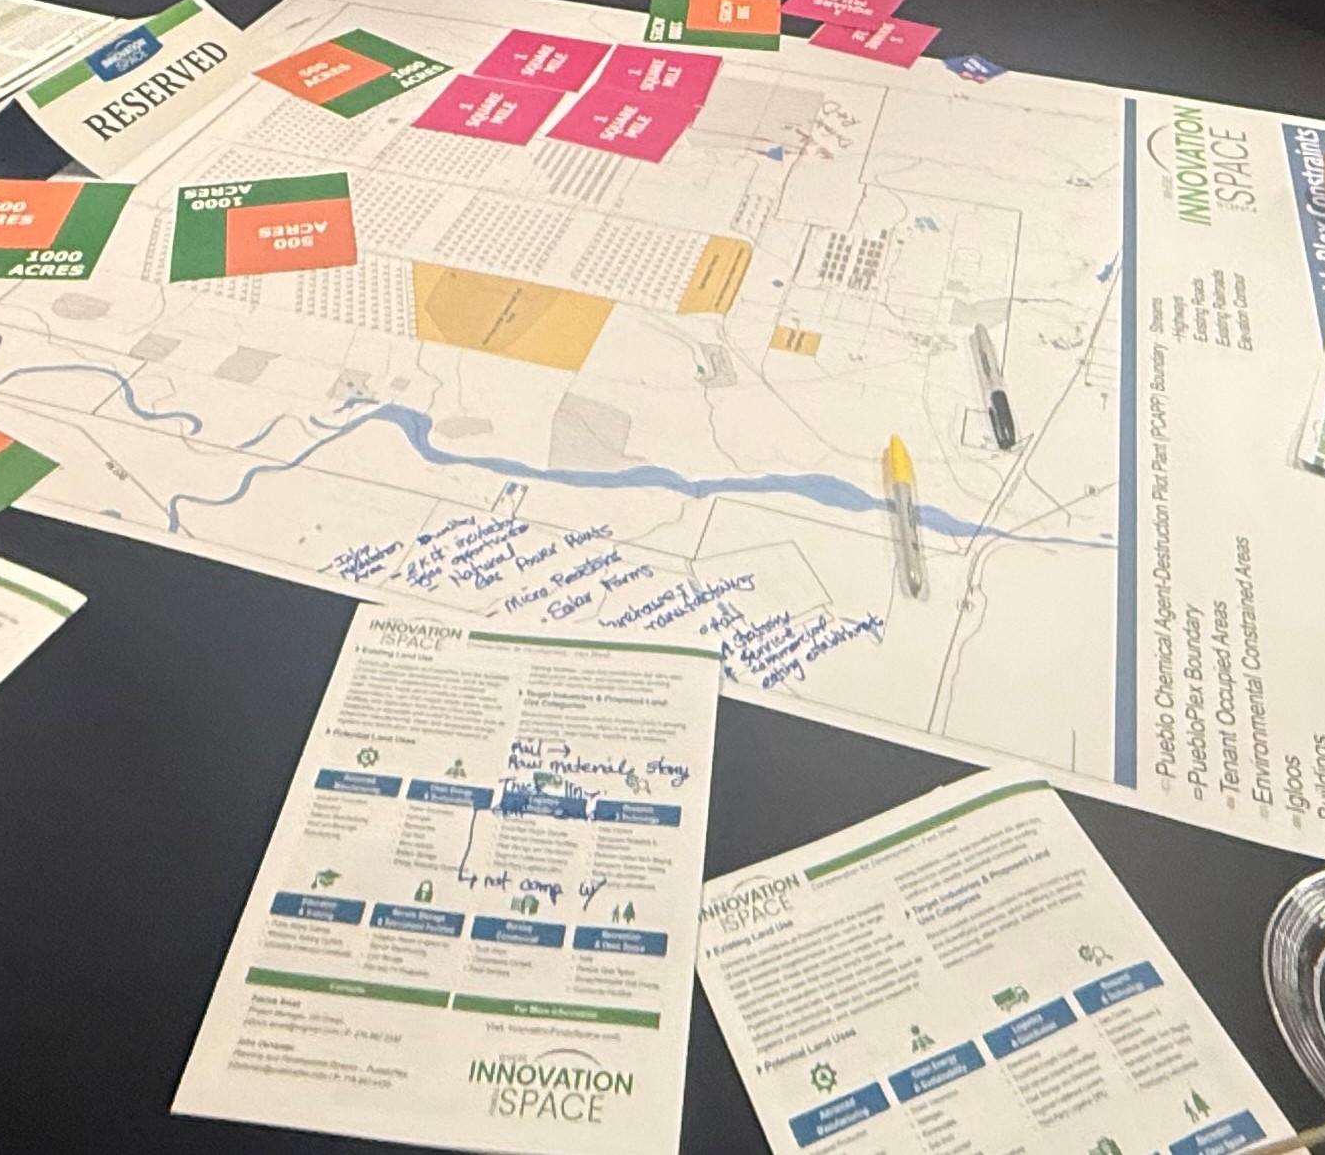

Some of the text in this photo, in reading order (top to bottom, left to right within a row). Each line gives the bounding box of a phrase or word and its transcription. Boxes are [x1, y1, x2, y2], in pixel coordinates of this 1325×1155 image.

[391, 60, 426, 80] 1000
[400, 64, 445, 88] ACRES
[521, 44, 556, 77] SQUARE
[543, 52, 568, 74] MILE
[639, 58, 666, 92] SQUARE
[661, 66, 682, 88] MILE
[82, 41, 228, 142] RESERVED
[465, 92, 503, 128] SQUARE
[489, 101, 518, 125] MILE
[600, 104, 639, 142] SQUARE
[625, 115, 652, 139] MILE
[1173, 105, 1212, 227] INNOVATION
[1209, 126, 1256, 206] SPACE
[184, 184, 253, 200] ACRES
[191, 196, 244, 211] 1000
[258, 221, 328, 239] ACRES
[273, 235, 314, 250] 500
[7, 263, 85, 276] ACRES
[25, 250, 84, 262] 1000
[1150, 297, 1162, 334] Streams
[1191, 277, 1209, 343] Existing Roads
[1212, 269, 1232, 347] Existing Railroads
[1233, 272, 1253, 351] Elevation Contour
[449, 543, 516, 589] Natural
[515, 543, 558, 573] Power
[1150, 343, 1176, 779] Pueblo Chemical Agent-Destruction Pilot Plant (PCAPP) Boundary
[504, 586, 549, 614] Micro
[547, 591, 592, 621] Solar
[370, 620, 463, 641] INNOVATION
[1233, 535, 1274, 807] Environmental Constrained Areas
[1184, 604, 1208, 788] PuebloPlex Boundary
[1211, 600, 1242, 794] Tenant Occupied Areas
[1282, 754, 1309, 823] Igloos
[485, 870, 512, 890] not
[912, 898, 938, 915] Target
[939, 880, 981, 902] Industries
[989, 858, 1029, 879] Proposed
[698, 873, 801, 923] INNOVATION
[916, 913, 935, 926] Use
[713, 935, 752, 957] Existing
[764, 1028, 857, 1072] Potential Land Uses
[469, 1060, 633, 1095] INNOVATION
[497, 1087, 606, 1124] SPACE
